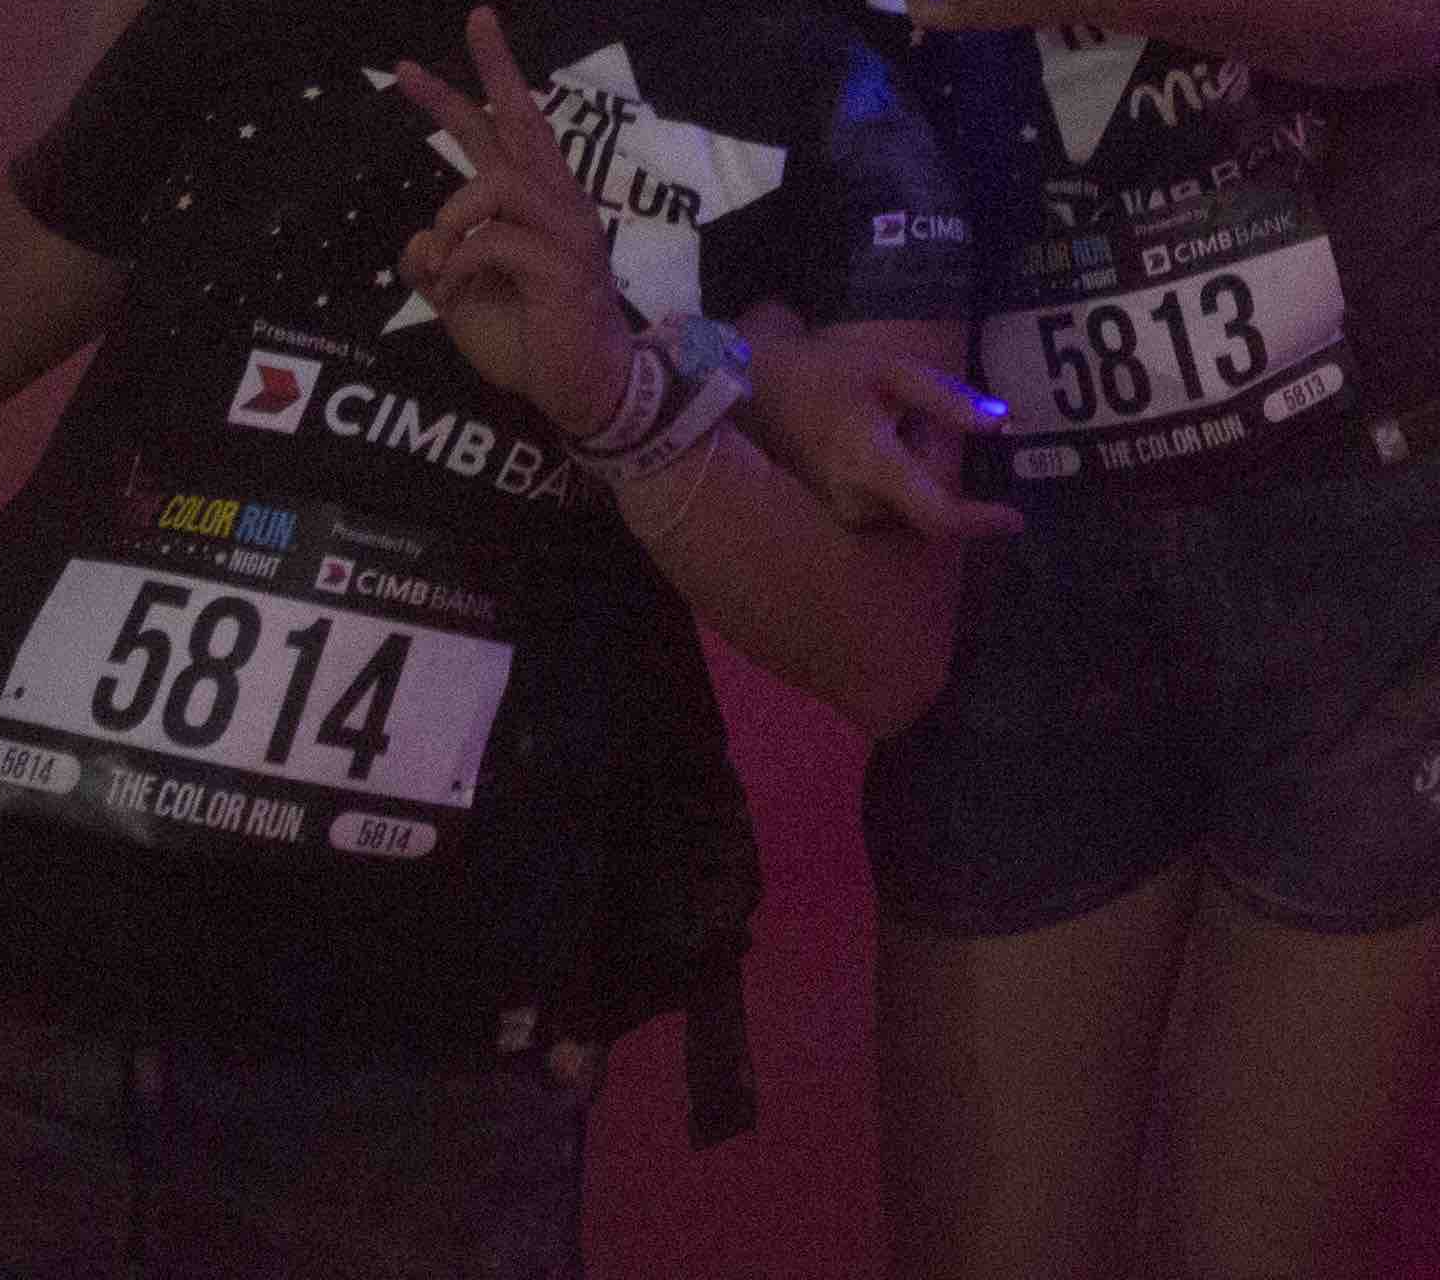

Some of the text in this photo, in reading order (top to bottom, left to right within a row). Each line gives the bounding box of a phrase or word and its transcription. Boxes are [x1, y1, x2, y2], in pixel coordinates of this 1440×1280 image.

[1173, 231, 1234, 265] CIMB
[252, 317, 377, 367] Presented by
[1037, 273, 1269, 424] 5813
[324, 383, 496, 477] CIMB
[1097, 439, 1138, 471] THE
[1135, 425, 1204, 464] COLOR
[1201, 413, 1247, 449] RUN
[1281, 374, 1327, 412] 5813
[159, 493, 239, 539] COLOR
[235, 503, 299, 550] RUN
[227, 547, 282, 579] NIGHT
[356, 569, 498, 618] CIMB BANK
[90, 580, 414, 781] 5814
[0, 746, 414, 855] 5814 THE COLOR RUN 5814
